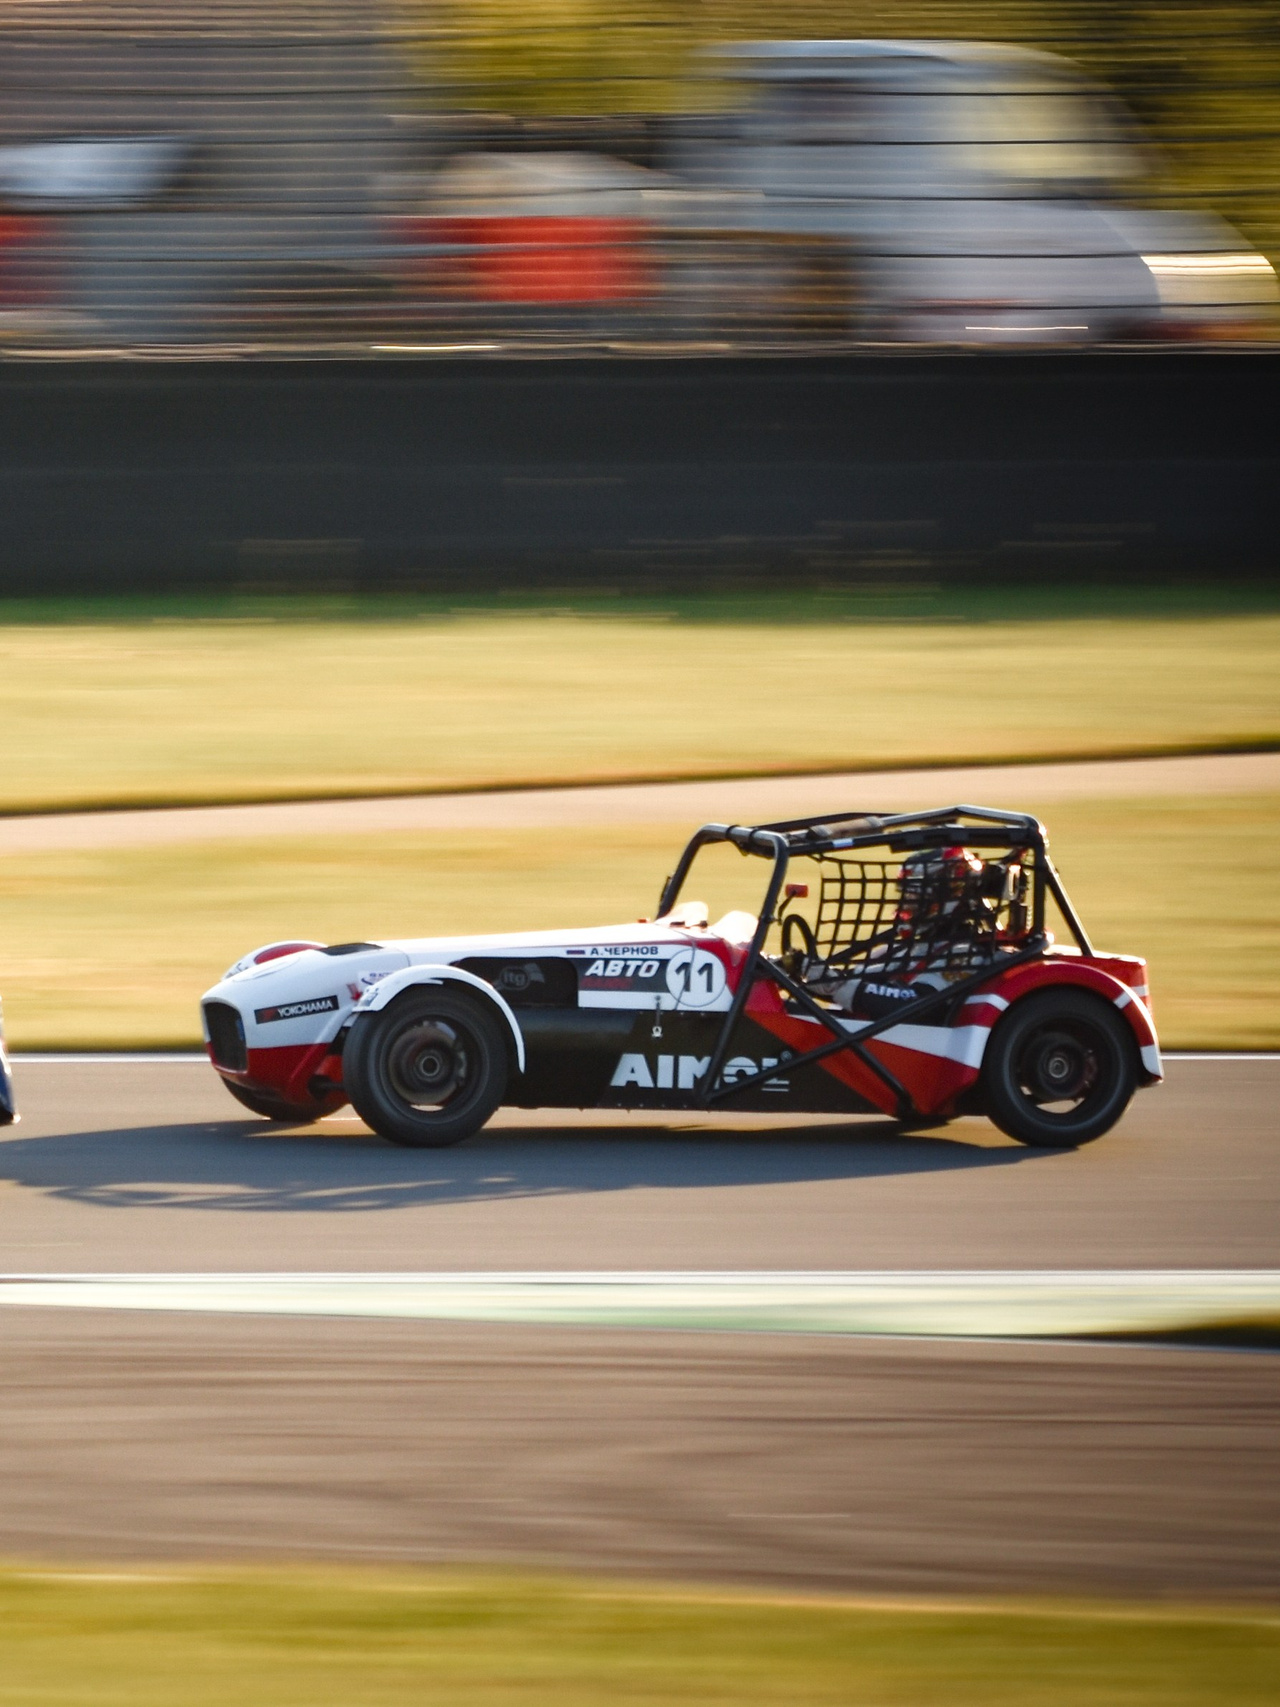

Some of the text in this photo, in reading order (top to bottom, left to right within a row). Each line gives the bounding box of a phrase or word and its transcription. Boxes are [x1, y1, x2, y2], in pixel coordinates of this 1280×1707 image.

[584, 960, 660, 978] АВТО
[674, 961, 714, 993] 11
[277, 1000, 334, 1018] YOKOHAMA
